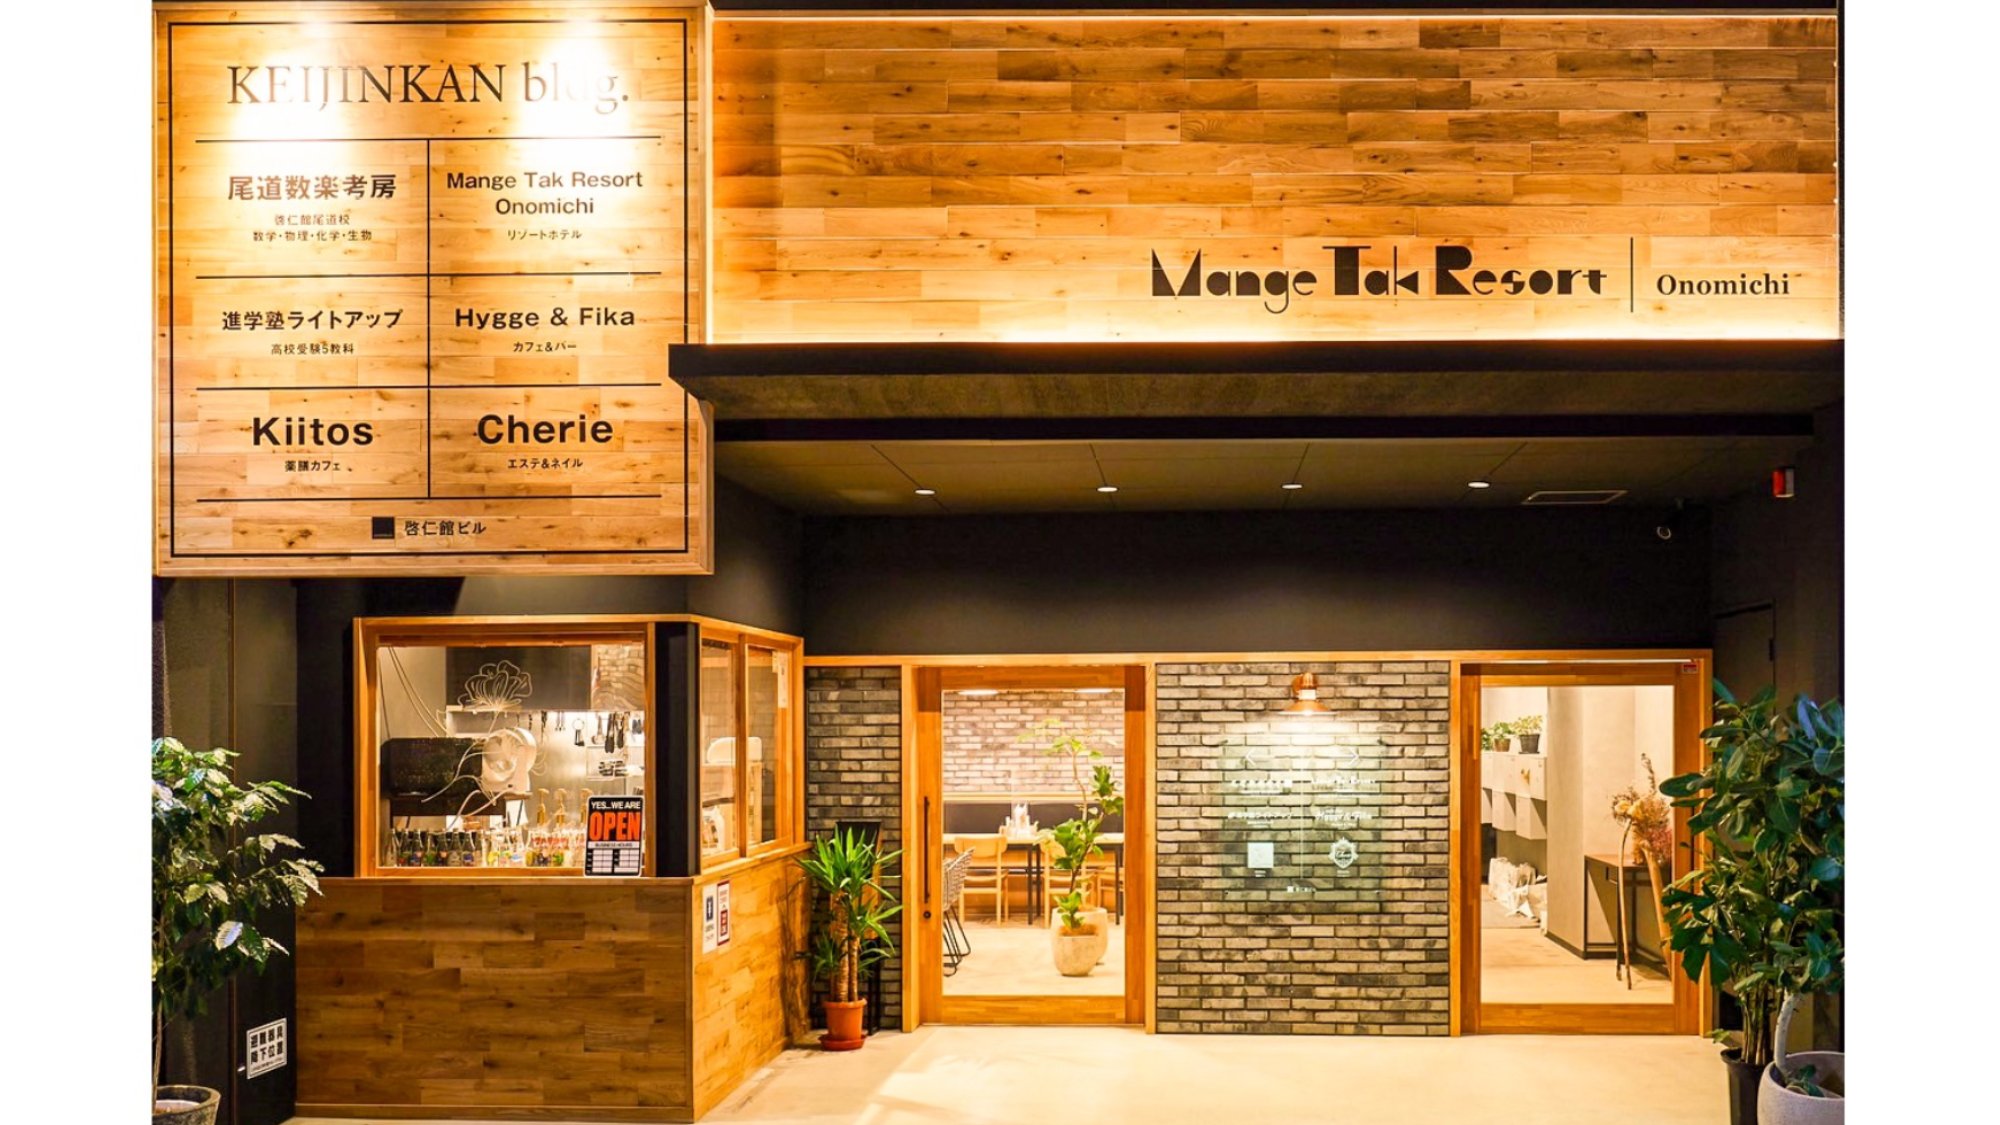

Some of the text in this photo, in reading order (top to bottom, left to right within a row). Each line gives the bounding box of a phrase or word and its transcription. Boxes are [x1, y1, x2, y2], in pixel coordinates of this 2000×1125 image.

[227, 64, 506, 112] KEIJINKAN
[228, 174, 397, 201] 尾道数楽考房
[446, 171, 644, 191] Mange Tak Resort
[495, 197, 595, 215] Onomichi
[507, 229, 583, 241] リゾートホテル
[1151, 245, 1608, 314] Mange Tak Resort
[1656, 272, 1791, 296] Onomichi
[222, 309, 404, 331] 進学塾ライトアップ
[455, 307, 636, 330] Hygge & Fika
[271, 343, 355, 355] 高校受験5教科
[252, 417, 374, 446] Kiitos
[477, 414, 613, 444] Cherie
[285, 460, 341, 473] 薬膳カフェ
[404, 519, 487, 536] 啓仁館ビル
[589, 811, 641, 841] OPEN
